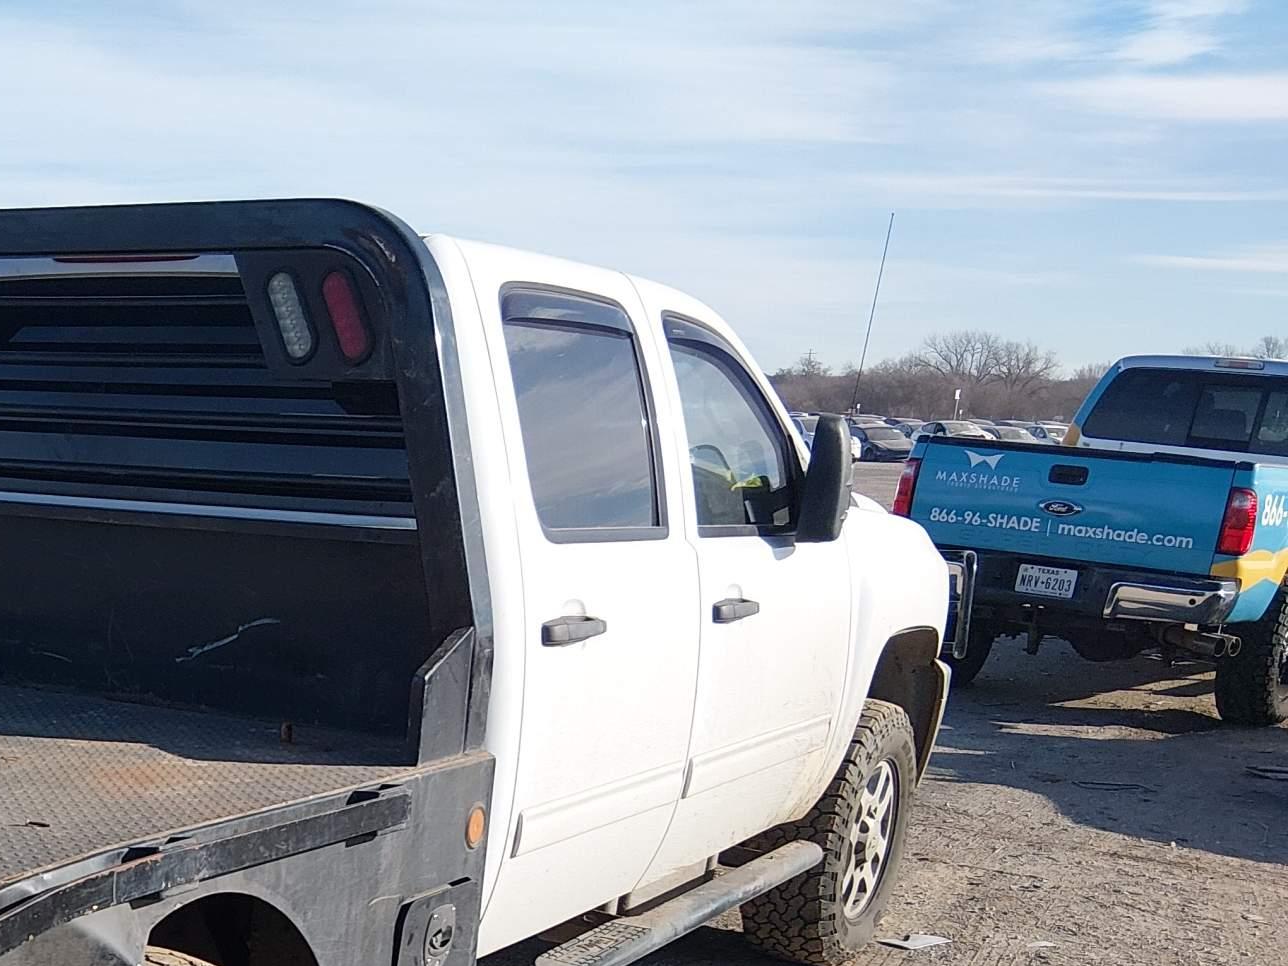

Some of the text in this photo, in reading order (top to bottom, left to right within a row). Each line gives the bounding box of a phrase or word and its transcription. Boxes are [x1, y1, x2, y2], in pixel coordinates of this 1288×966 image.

[935, 470, 1021, 488] MAXSHADE
[1261, 494, 1288, 527] 866-
[929, 507, 1041, 532] 866-96-SHADE
[1057, 521, 1194, 550] maxshade.com
[1037, 567, 1060, 576] TEXAS
